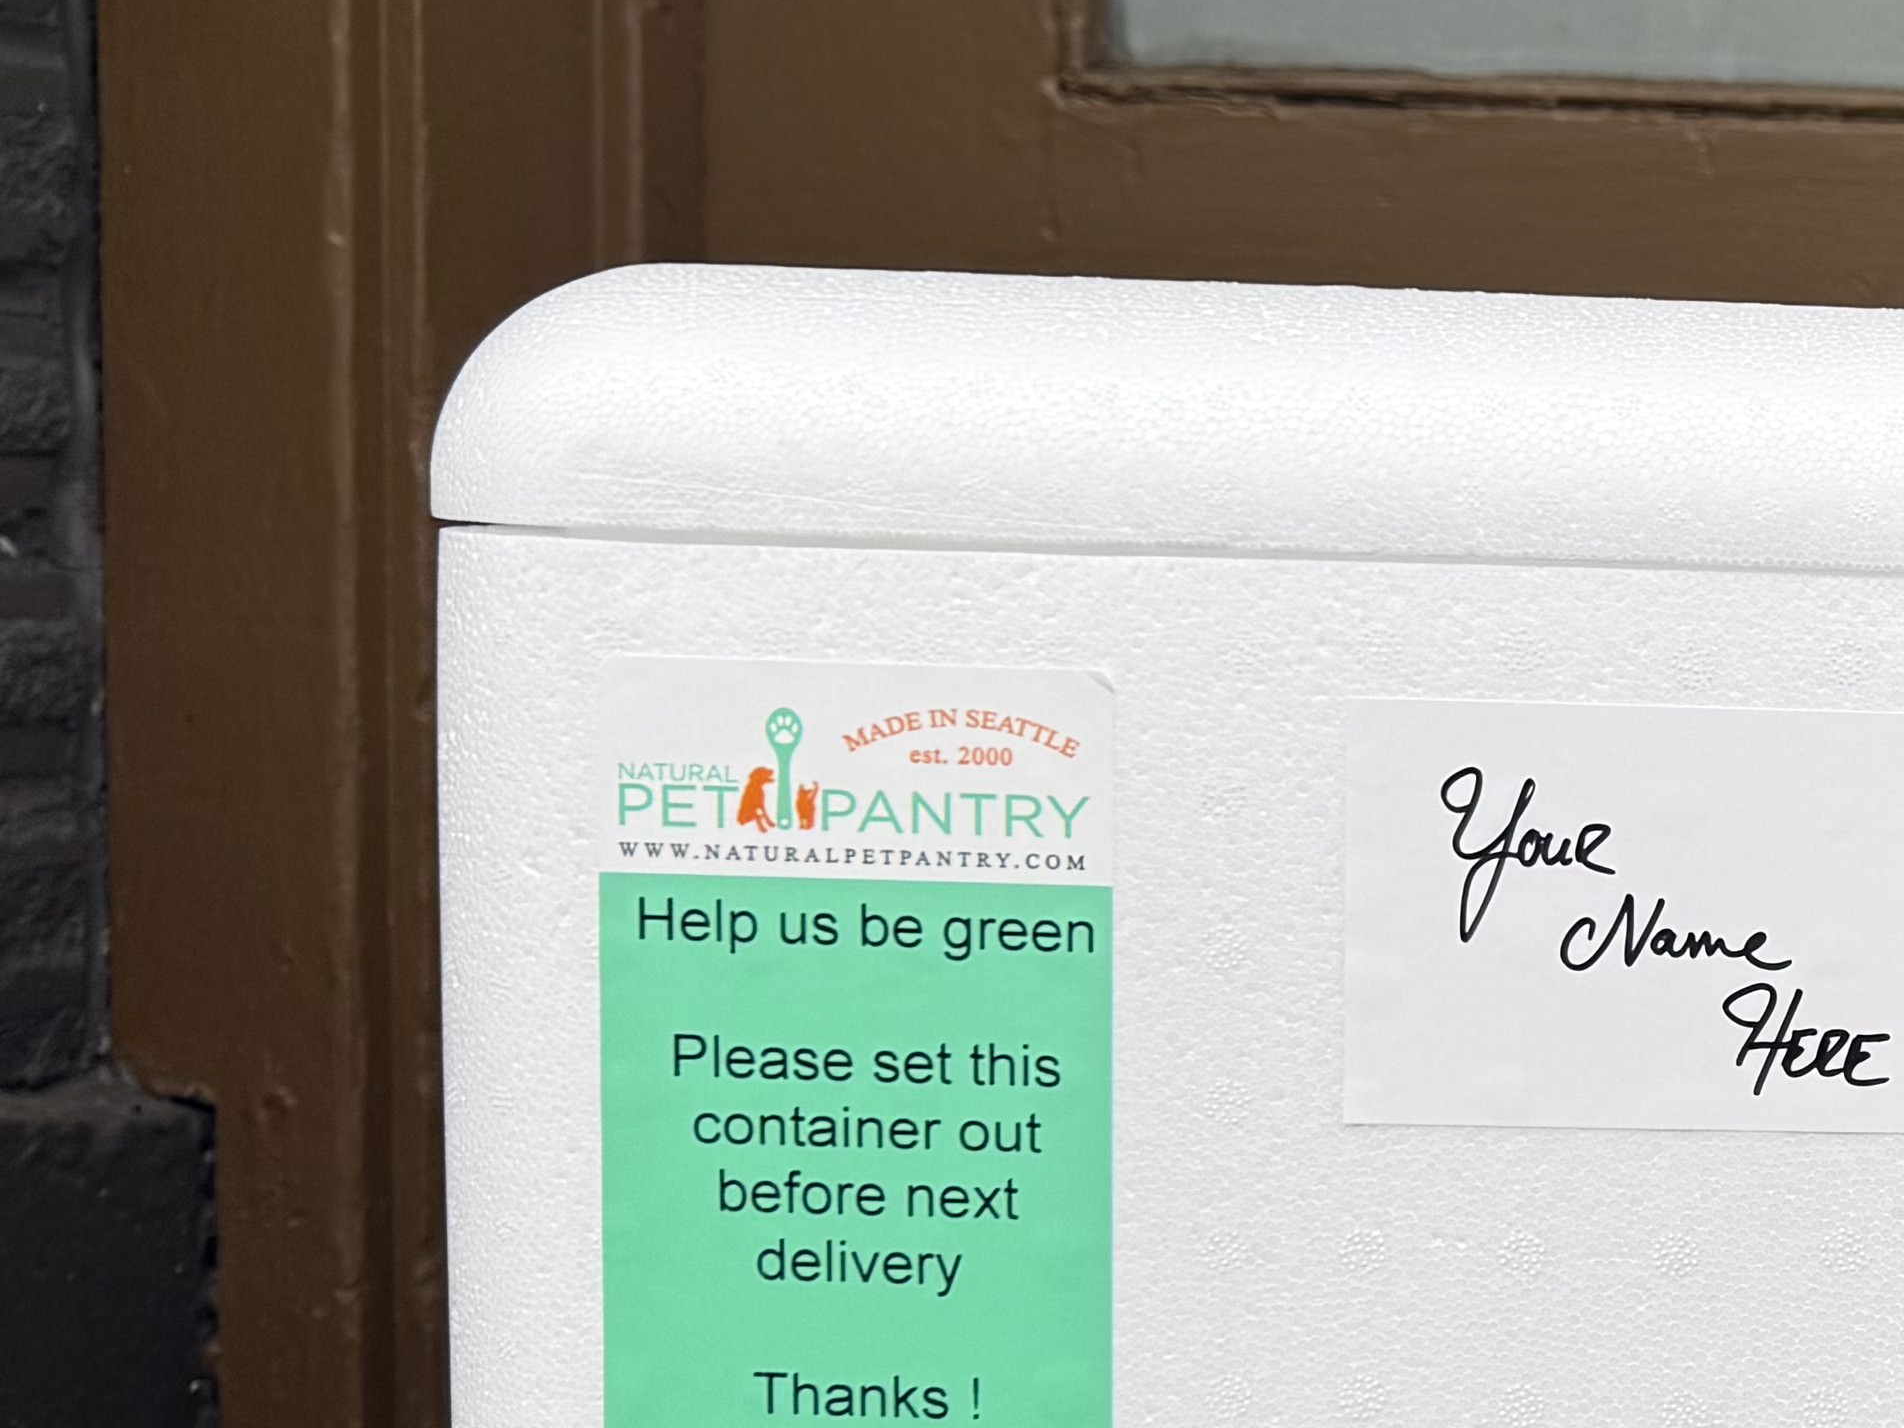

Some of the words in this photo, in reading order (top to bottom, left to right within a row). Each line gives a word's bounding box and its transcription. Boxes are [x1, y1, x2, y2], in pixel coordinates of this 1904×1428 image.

[842, 711, 921, 753] MADE
[928, 708, 958, 729] IN
[965, 708, 1081, 759] SEATTLE
[908, 748, 948, 765] est.
[957, 745, 1013, 767] 2000
[618, 762, 737, 783] NATURAL
[619, 783, 739, 827] PET
[821, 788, 1090, 840] PANTRY
[618, 841, 1086, 871] WWW.NATURALPETPANTRY.COM
[638, 896, 758, 955] Help
[780, 912, 839, 946] us
[861, 903, 923, 949] be
[943, 916, 1094, 962] green
[1559, 893, 1793, 972] Name
[673, 1033, 854, 1082] Please
[873, 1043, 953, 1085] set
[969, 1042, 1061, 1088] this
[1721, 982, 1891, 1096] HERE
[693, 1106, 942, 1150] container
[959, 1113, 1042, 1154] out
[719, 1168, 886, 1217] before
[907, 1178, 1019, 1221] next
[756, 1238, 962, 1298] delivery
[753, 1371, 949, 1420] Thanks
